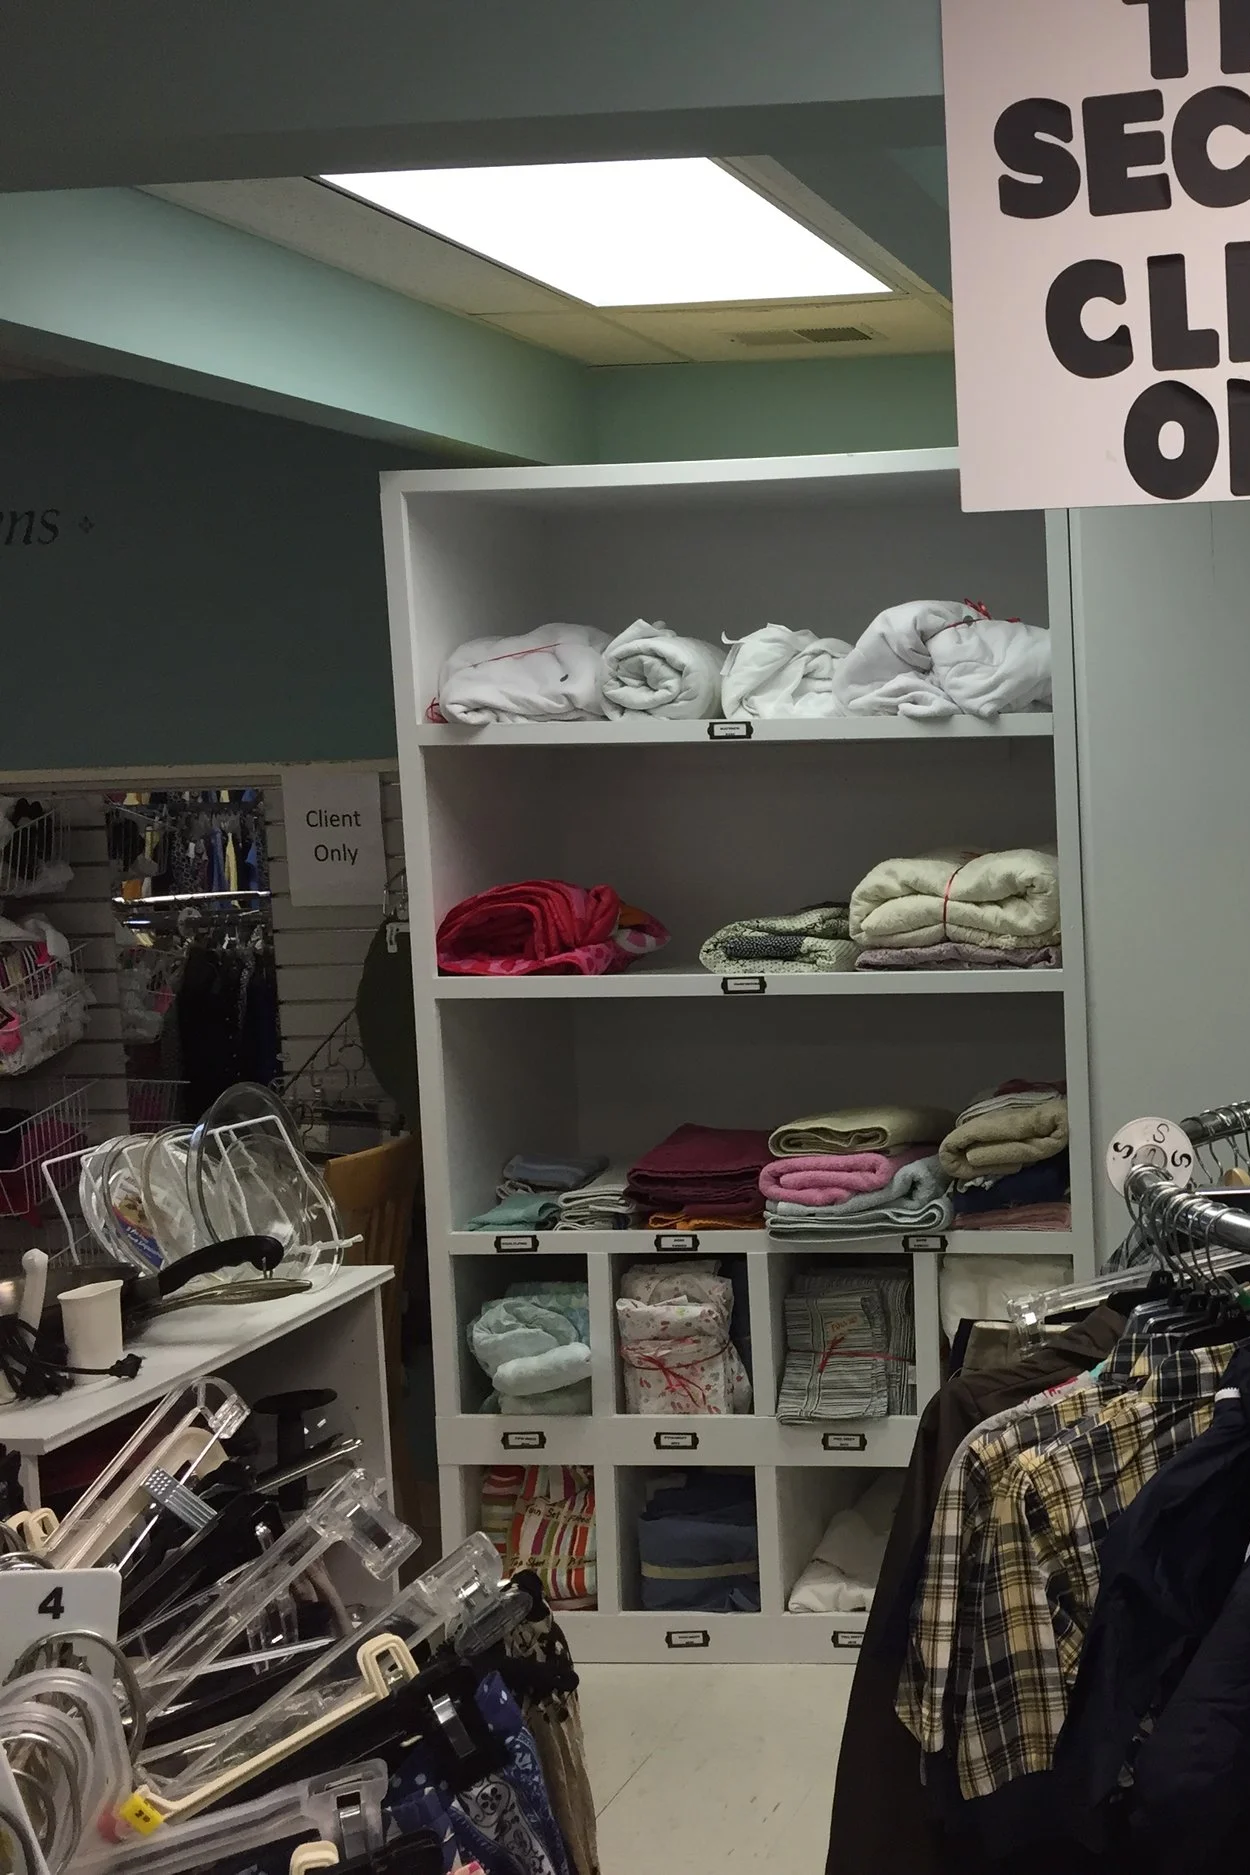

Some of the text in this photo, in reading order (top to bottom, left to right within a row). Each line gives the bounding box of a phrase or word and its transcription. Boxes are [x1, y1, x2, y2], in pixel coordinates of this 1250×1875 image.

[0, 509, 60, 545] ns
[306, 809, 361, 827] Client
[314, 843, 358, 866] Only
[38, 1586, 65, 1620] 4
